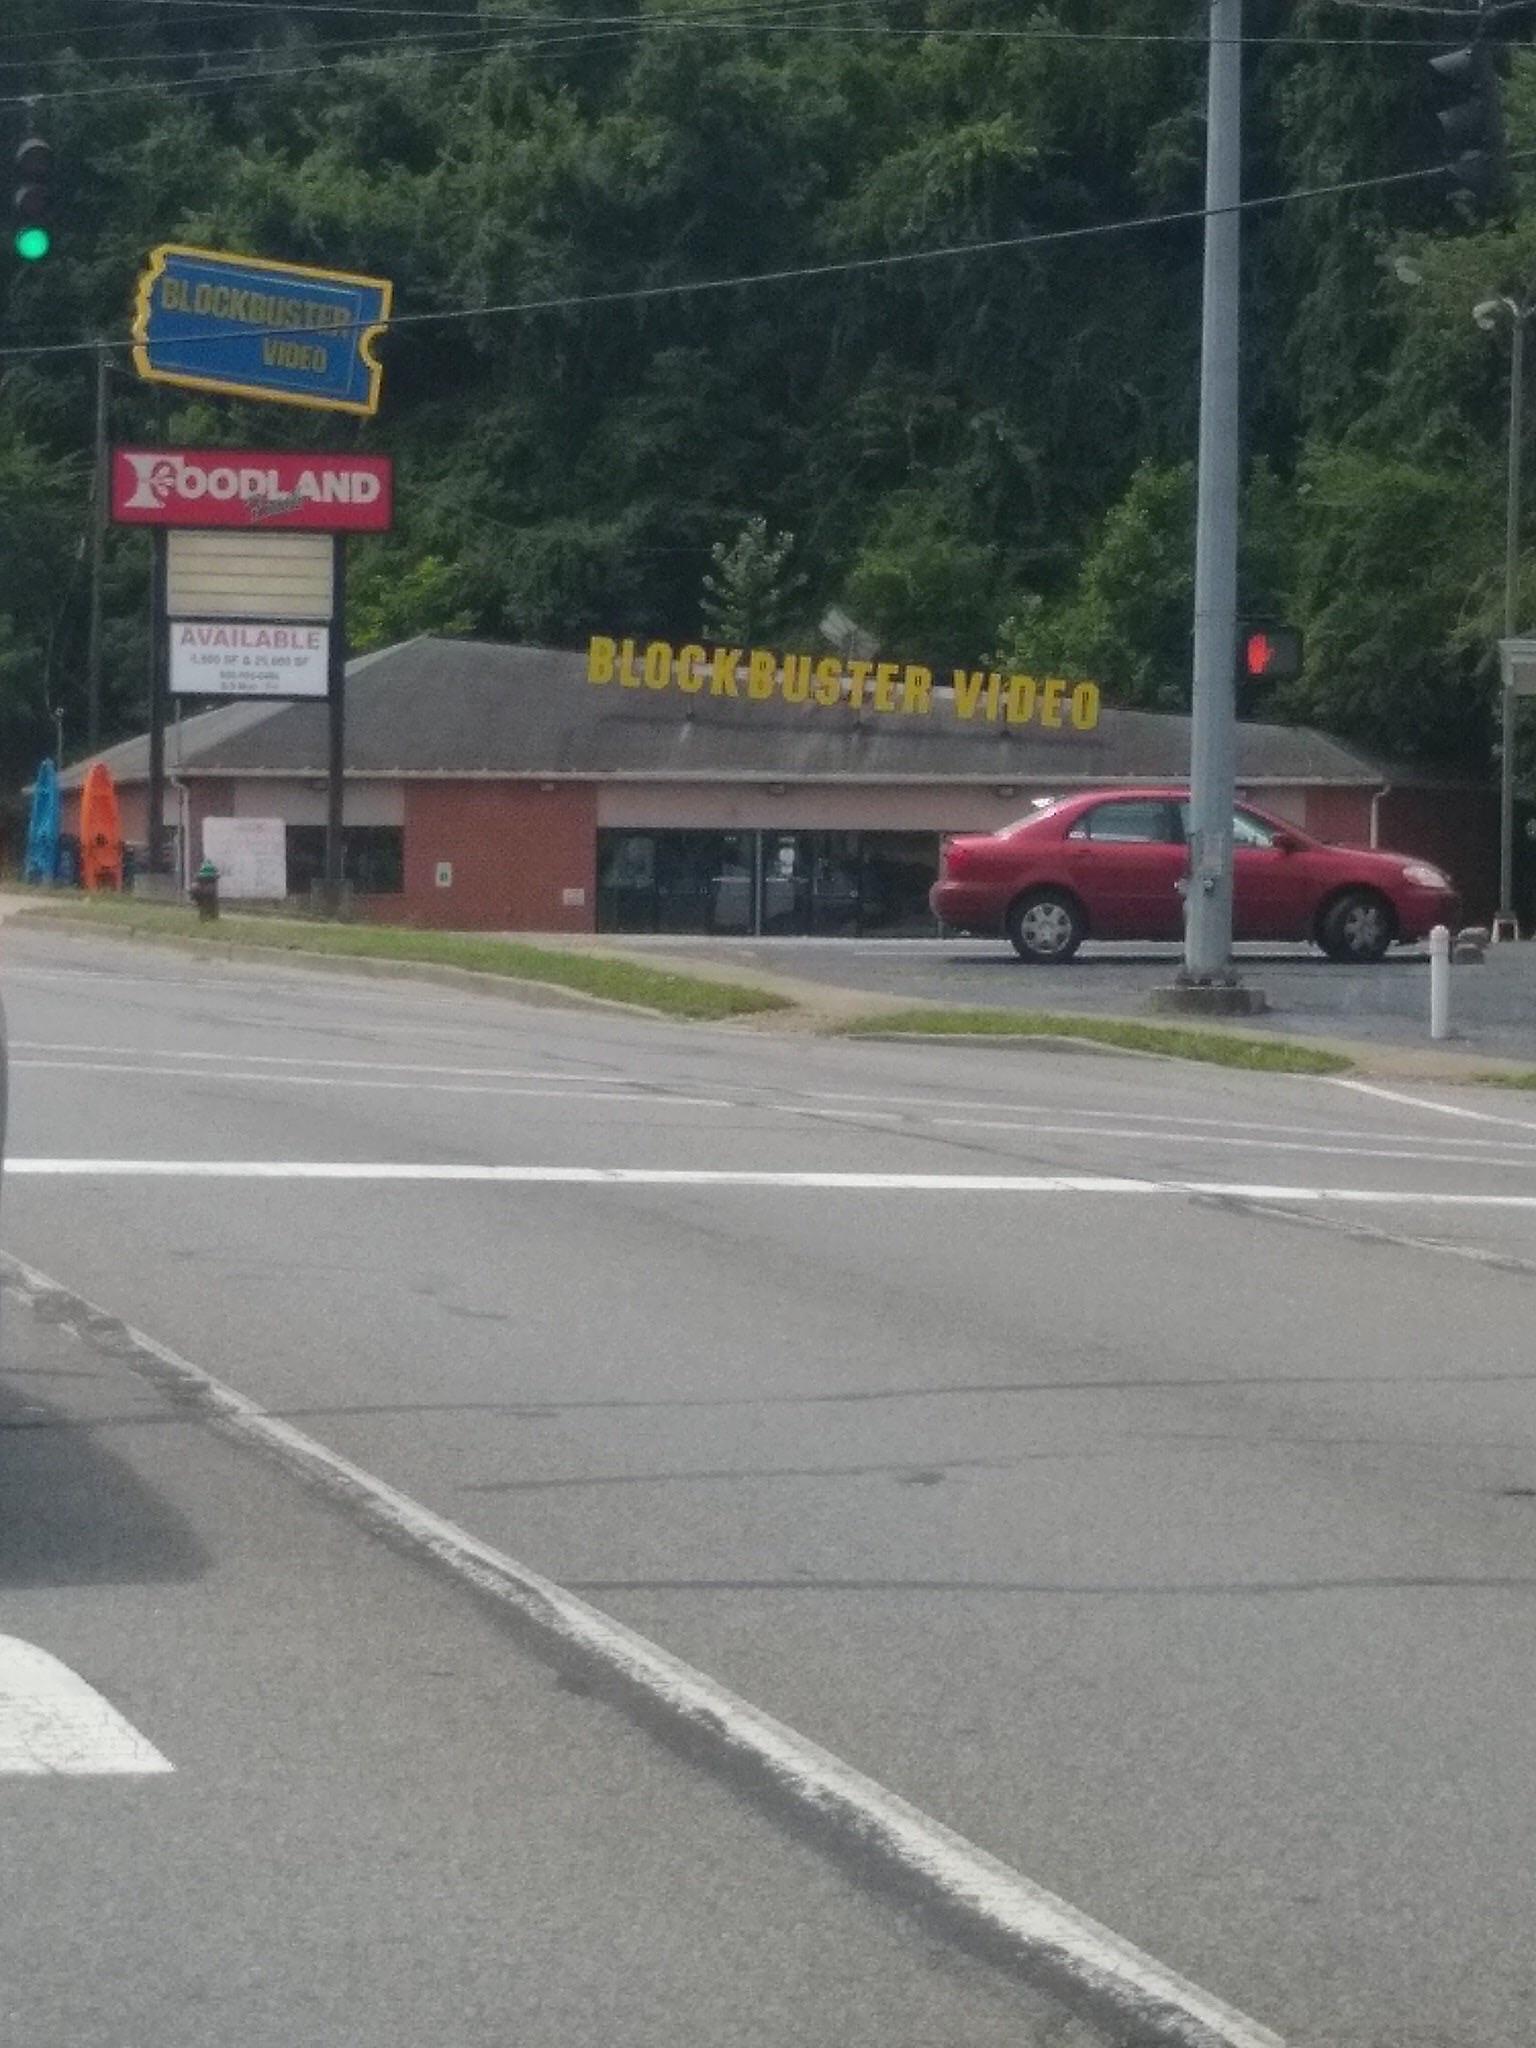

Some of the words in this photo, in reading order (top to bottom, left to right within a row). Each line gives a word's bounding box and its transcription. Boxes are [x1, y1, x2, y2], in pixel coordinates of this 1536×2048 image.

[161, 277, 351, 337] BLOCKBUSTER
[262, 337, 328, 374] VIDEO
[124, 453, 381, 509] FOODLAND
[180, 627, 321, 650] AVAILABLE
[586, 635, 933, 715] BLOCKBUSTER
[952, 668, 1101, 731] VIDEO
